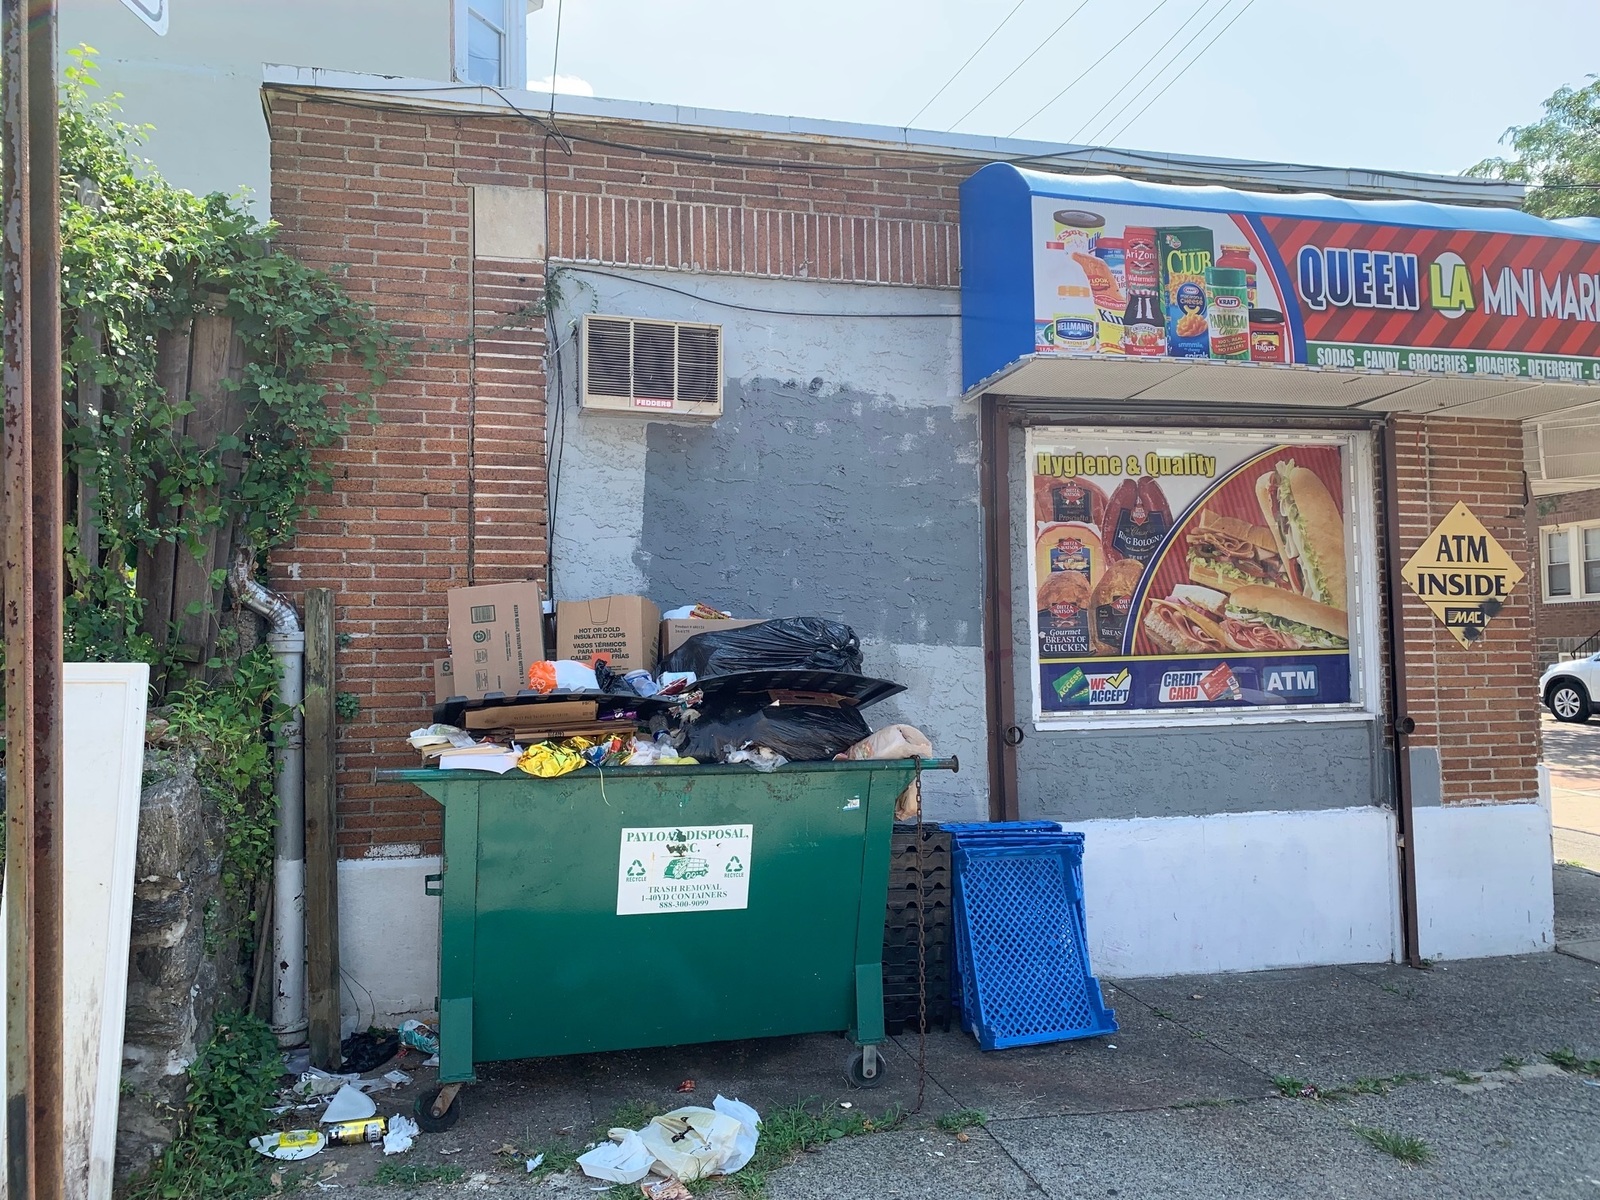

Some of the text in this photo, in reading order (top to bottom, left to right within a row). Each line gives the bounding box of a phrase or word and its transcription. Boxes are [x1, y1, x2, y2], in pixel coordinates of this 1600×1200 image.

[1166, 250, 1212, 275] CLUB
[1296, 244, 1420, 311] QUEEN
[1429, 262, 1476, 311] LA
[1482, 264, 1536, 318] MINI
[1255, 342, 1276, 353] Folgers
[1317, 347, 1355, 367] SODAS
[1363, 349, 1400, 370] CANDY
[1408, 352, 1468, 373] GROCERIES
[1475, 355, 1520, 376] HOAGIES
[1527, 359, 1583, 379] DETERGENT
[636, 398, 672, 408] FEDDERS
[1037, 452, 1216, 478] Hygiene & Quality
[1132, 534, 1164, 547] BOLOGNA
[1435, 534, 1490, 563] ATM
[1417, 573, 1509, 597] INSIDE
[1449, 611, 1482, 624] MAC
[1049, 628, 1081, 638] Gourmet
[1101, 628, 1123, 636] BREAS
[1042, 643, 1088, 652] CHICKEN
[442, 661, 450, 672] 6
[1058, 669, 1083, 698] ACCESS
[1090, 678, 1106, 690] WE
[1163, 672, 1203, 686] CREDIT
[1267, 671, 1315, 692] ATM
[1090, 689, 1129, 703] ACCEPT
[1168, 686, 1198, 700] CARD
[686, 828, 750, 841] DISPOSAL,
[648, 883, 722, 894] TRASH REMOVAL
[641, 891, 728, 902] 1-40YD CONTAINERS
[659, 900, 709, 909] 888-300-9099
